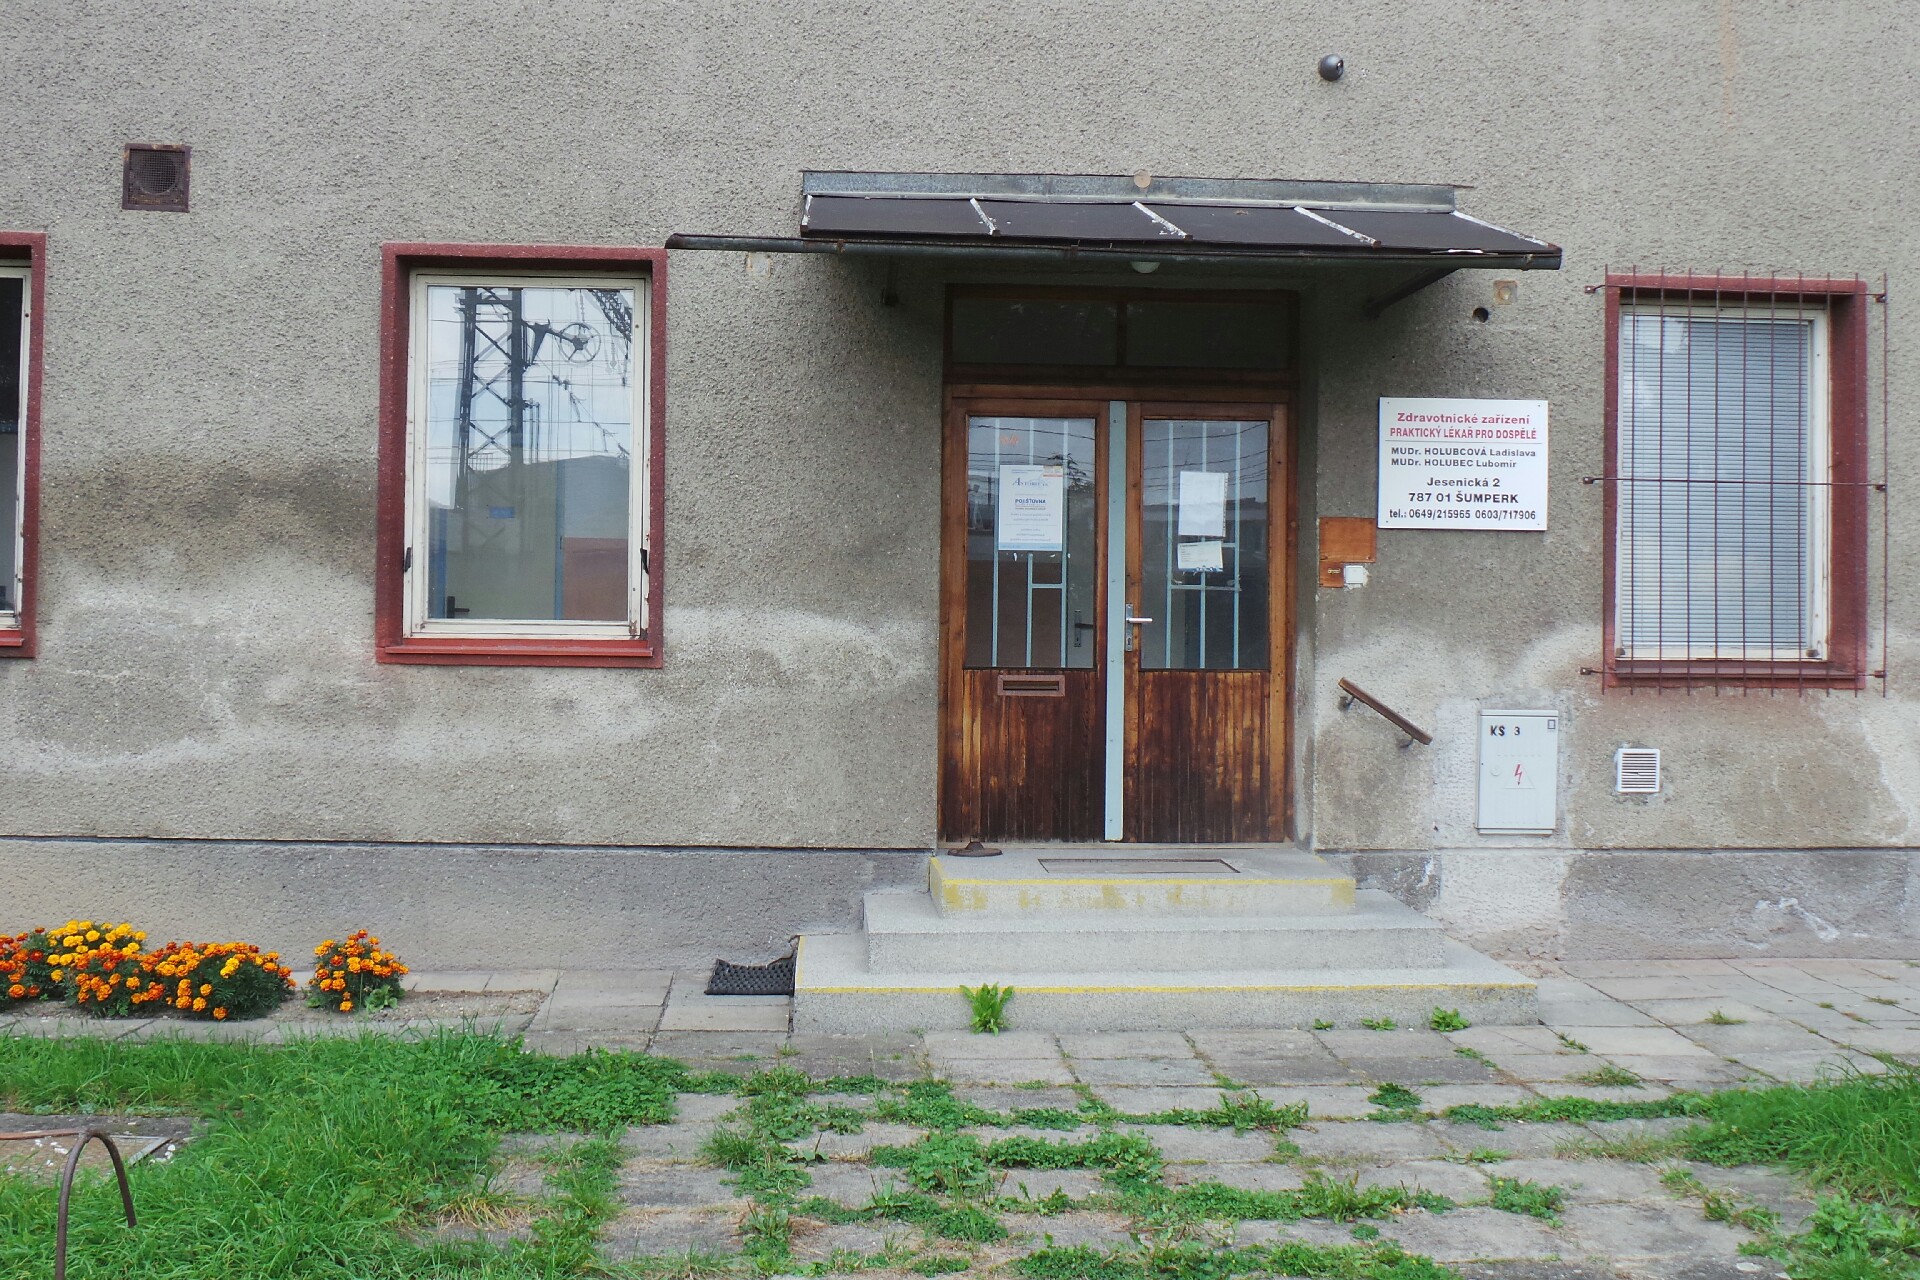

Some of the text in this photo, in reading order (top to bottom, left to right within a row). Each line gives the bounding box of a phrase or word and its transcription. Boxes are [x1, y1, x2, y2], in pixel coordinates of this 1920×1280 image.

[1397, 412, 1530, 425] Zdravotnické zařízení
[1390, 425, 1536, 440] PRAKTICKÝ LÉKAŘ PRO DOSPĚLÉ
[1391, 446, 1536, 457] MUDr. HOLUBCOVÁ Ladislava
[1391, 458, 1421, 466] MUDr.
[1424, 459, 1474, 467] HOLUBEC
[1427, 477, 1501, 487] Jesenická 2
[1409, 490, 1519, 504] 787 01 ŠUMPERK
[1389, 509, 1536, 521] tel.: 0649/215965 0603/717906
[1490, 725, 1521, 737] KS 3
